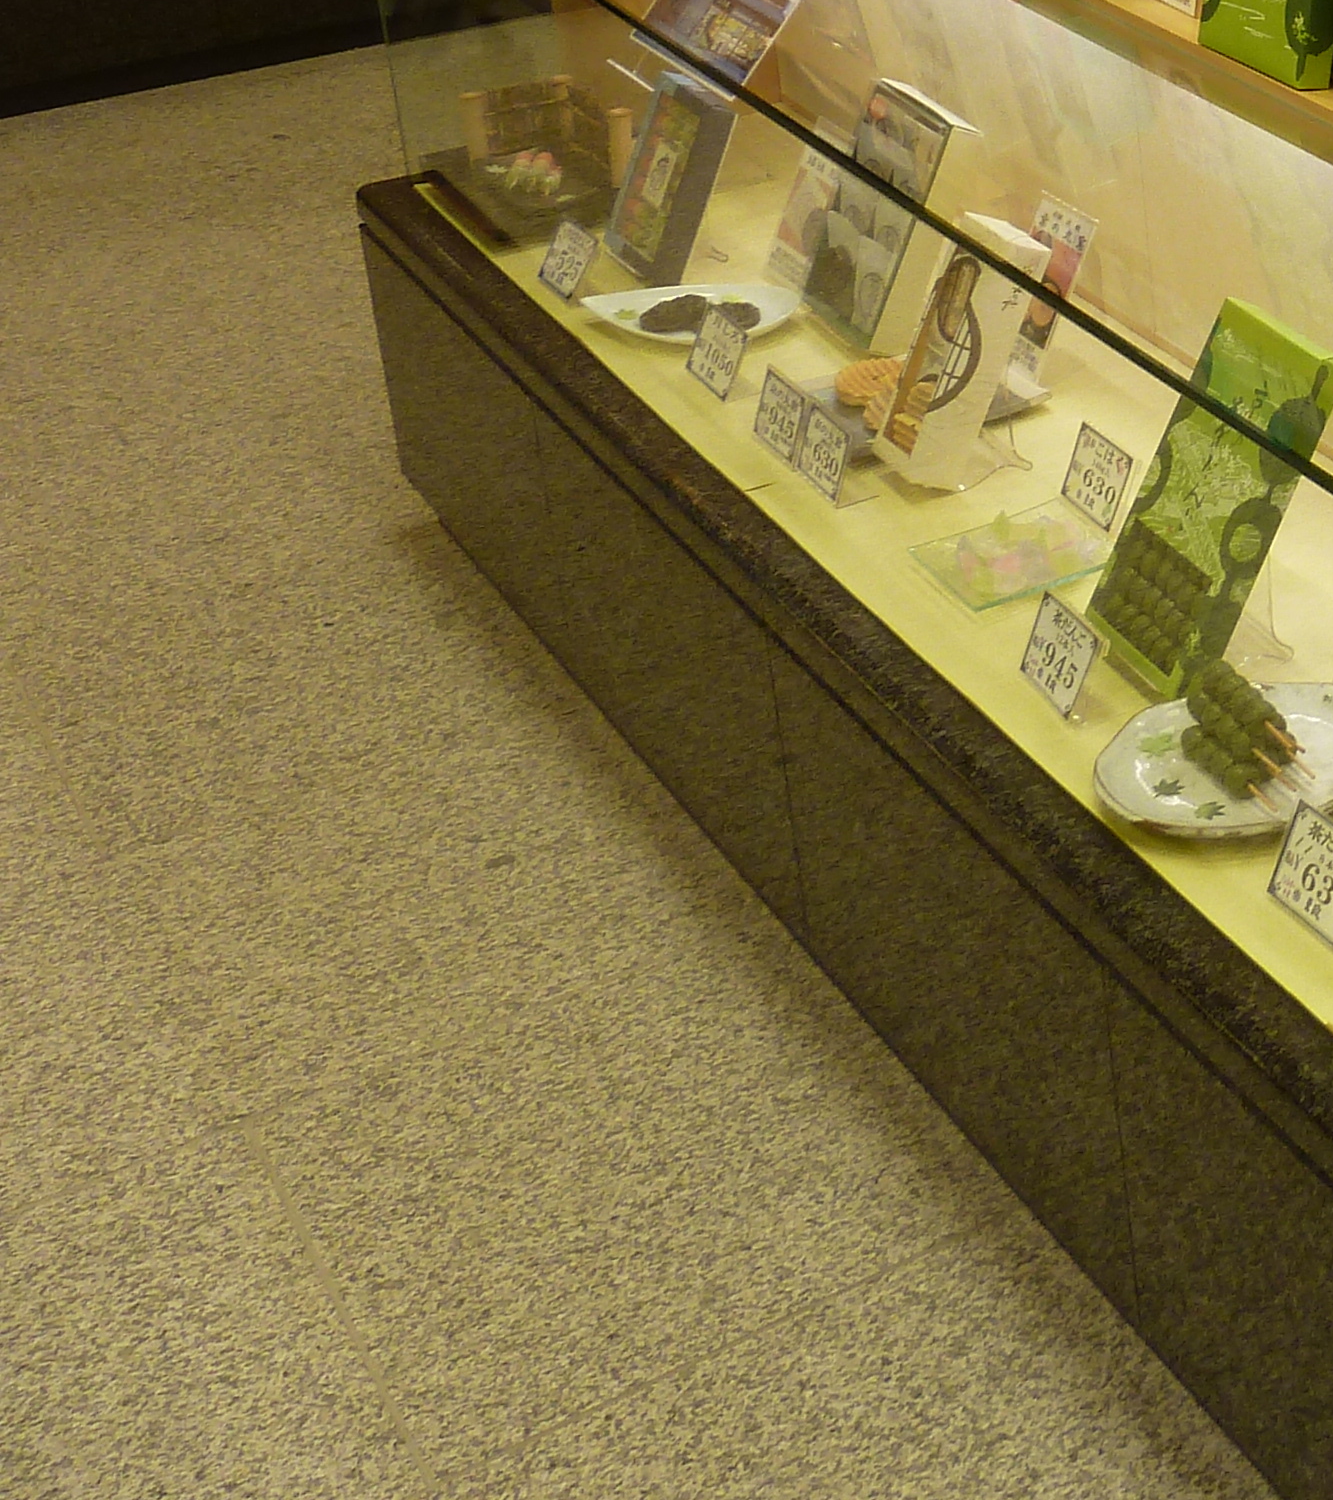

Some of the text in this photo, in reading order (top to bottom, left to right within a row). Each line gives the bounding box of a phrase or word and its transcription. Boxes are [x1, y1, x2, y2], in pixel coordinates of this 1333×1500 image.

[813, 444, 838, 476] 630
[1083, 469, 1115, 505] 630
[1052, 609, 1087, 649] 茶だんご
[1042, 642, 1078, 689] 945
